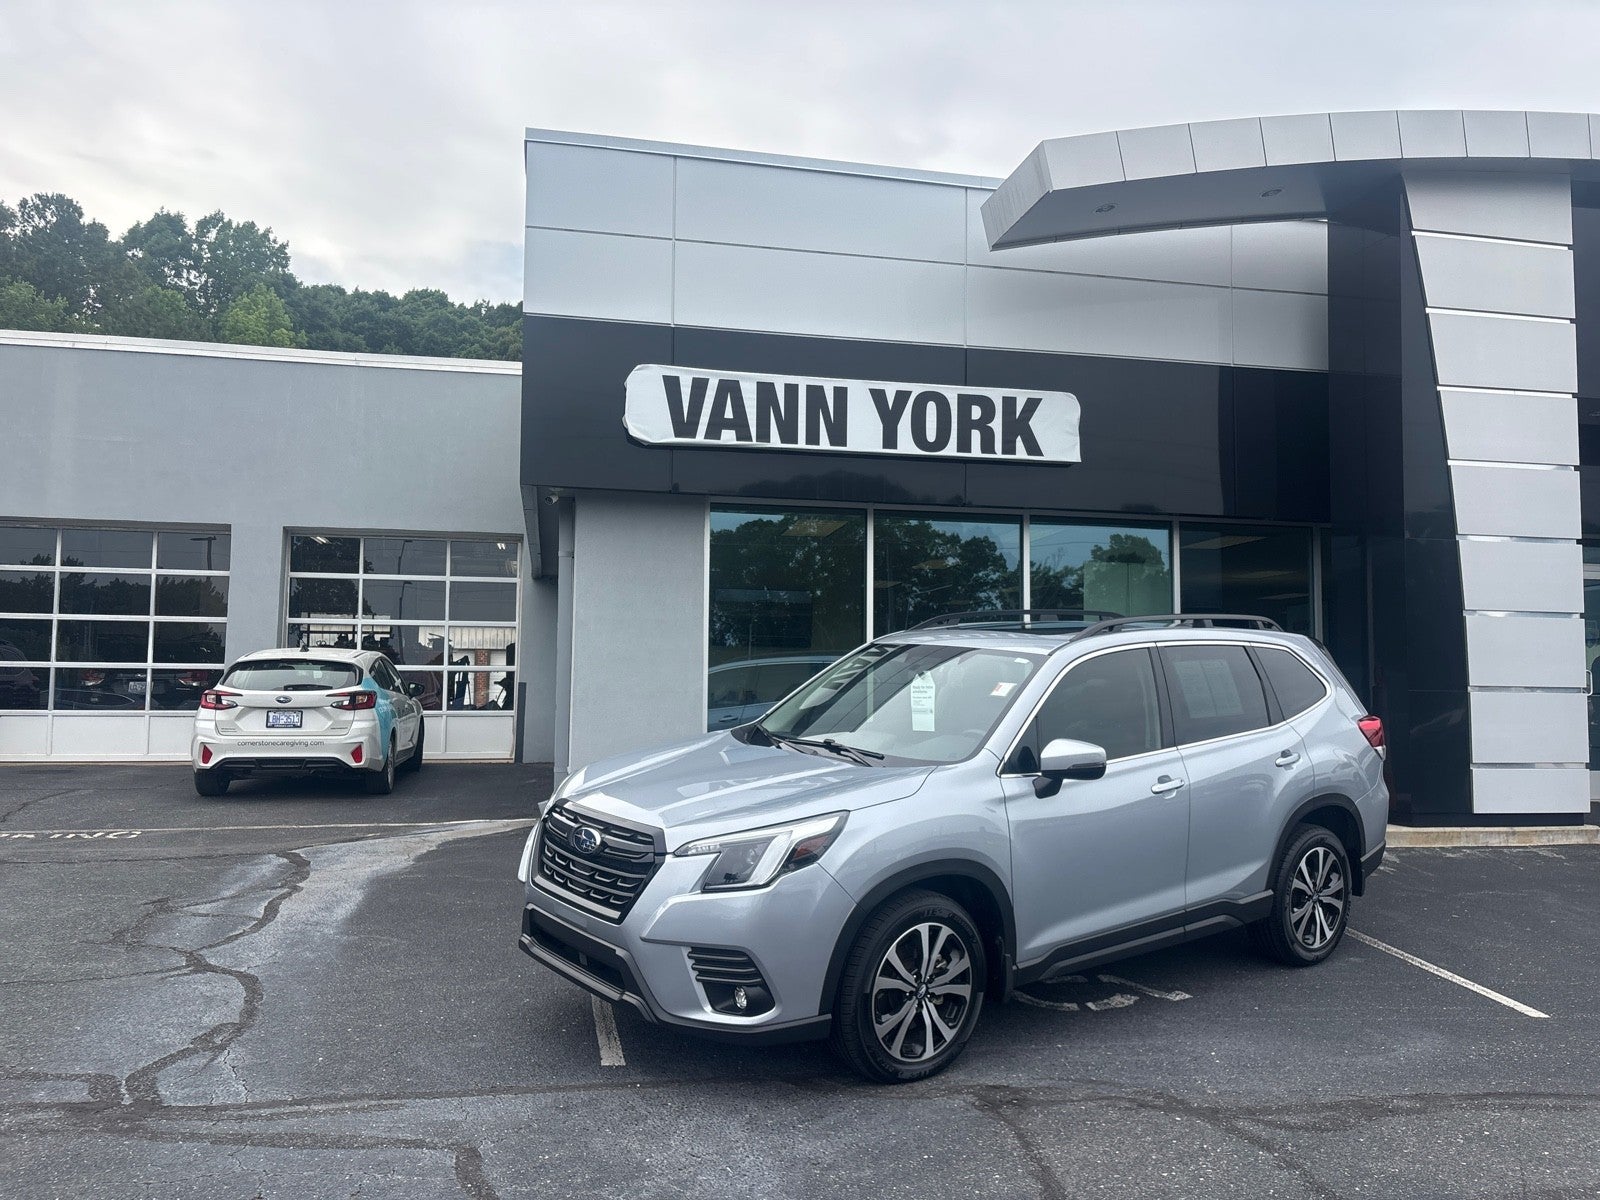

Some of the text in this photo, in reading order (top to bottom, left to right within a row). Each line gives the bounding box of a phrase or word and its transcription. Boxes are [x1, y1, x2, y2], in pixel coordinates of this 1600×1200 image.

[662, 375, 1044, 458] VANN YORK
[237, 740, 325, 748] cornerstonecaregiving.com
